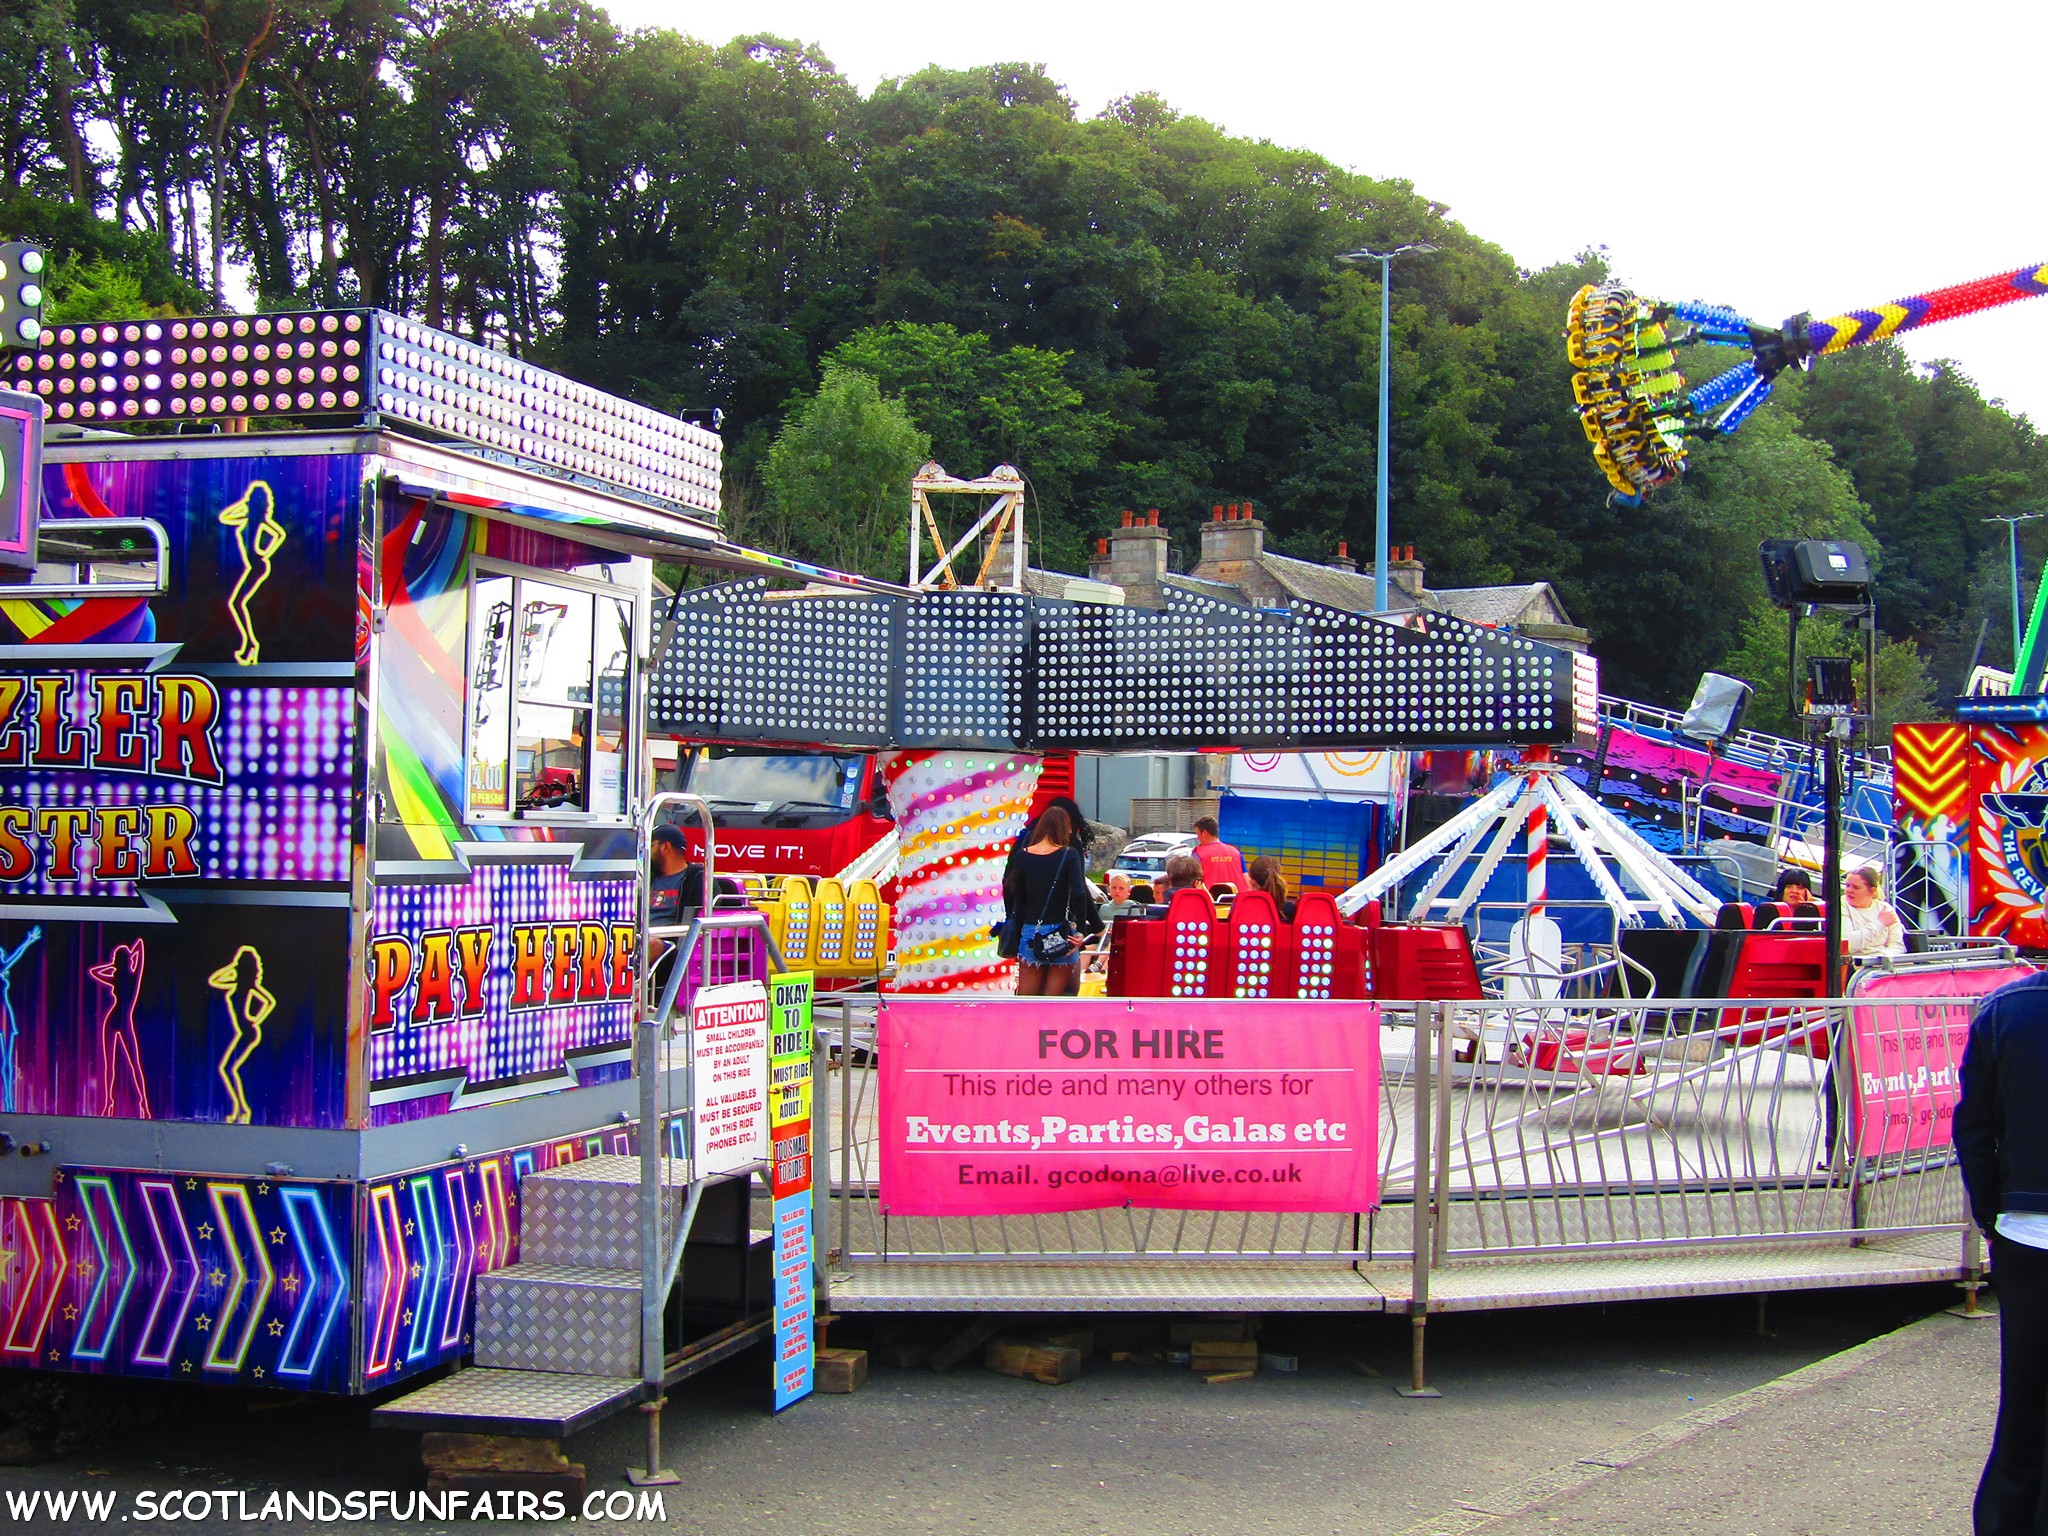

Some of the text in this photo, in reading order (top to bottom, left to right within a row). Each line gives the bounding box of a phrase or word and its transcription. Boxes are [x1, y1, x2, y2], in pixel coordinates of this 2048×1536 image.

[477, 793, 504, 804] PERSON
[0, 804, 200, 882] STER
[776, 846, 804, 859] IT!
[2003, 830, 2019, 865] THE
[371, 921, 634, 1035] PAY HERE
[776, 984, 809, 1007] OKAY
[697, 1002, 764, 1028] ATTENTION
[784, 1009, 800, 1029] TO
[706, 1028, 756, 1043] SMALL CHILDREN
[1039, 1029, 1224, 1059] FOR HIRE
[1926, 1033, 1944, 1049] and
[697, 1040, 764, 1058] MUST BE ACCOMPANIED
[714, 1055, 750, 1069] BY AN ADULT
[713, 1068, 751, 1083] ON THIS RIDE
[773, 1063, 809, 1084] MUST RIDE
[943, 1074, 1313, 1100] This ride and many others for
[706, 1088, 757, 1108] ALL VALUABLES
[700, 1101, 762, 1124] MUST BE SECURED
[710, 1117, 754, 1136] ON THIS RIDE
[1294, 1118, 1346, 1141] etc
[706, 1136, 737, 1154] (PHONES
[775, 1135, 808, 1161] TOO SMALL
[778, 1162, 787, 1184] TO
[958, 1163, 1301, 1188] Email. gcodona@live.co.uk
